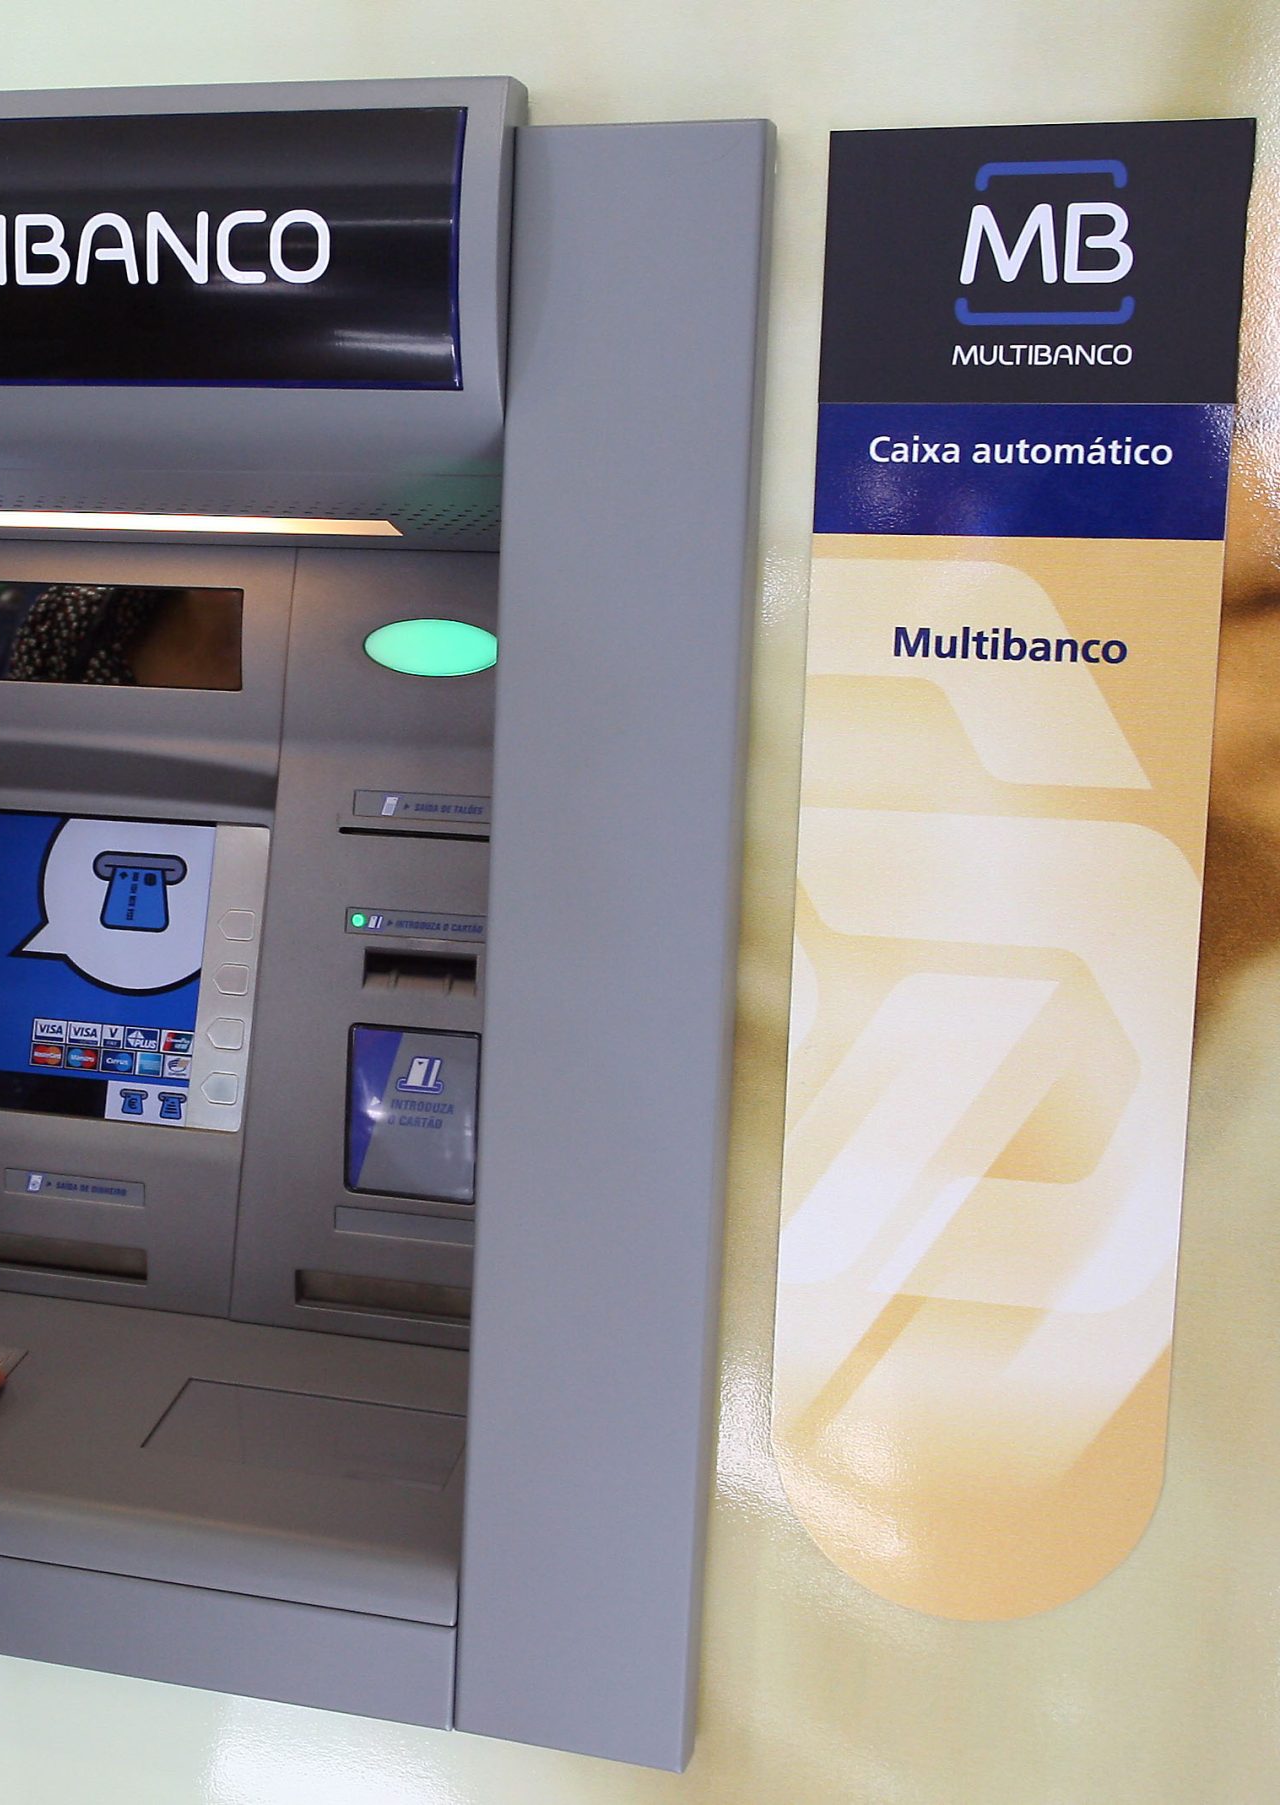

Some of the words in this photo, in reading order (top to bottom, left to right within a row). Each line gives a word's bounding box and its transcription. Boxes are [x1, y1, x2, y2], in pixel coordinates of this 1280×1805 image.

[960, 202, 1134, 284] MB
[951, 344, 1132, 366] MULTIBANCO
[869, 434, 960, 465] Caixa
[973, 436, 1173, 467] automático
[894, 627, 1128, 664] Multibanco
[39, 1024, 63, 1034] VISA
[72, 1026, 97, 1038] VISA
[133, 1038, 157, 1049] PLUS
[390, 1099, 454, 1115] INTRODUZA
[399, 1115, 443, 1129] CARTÃO
